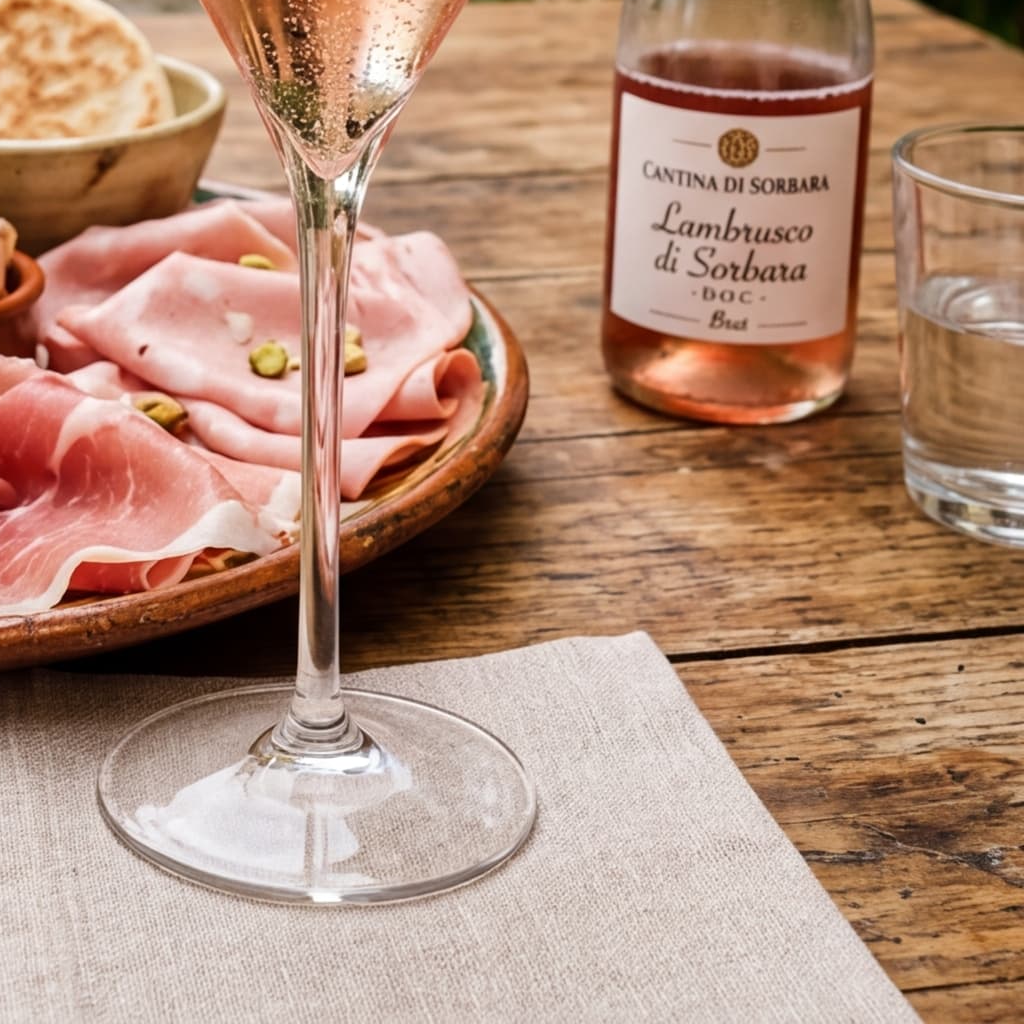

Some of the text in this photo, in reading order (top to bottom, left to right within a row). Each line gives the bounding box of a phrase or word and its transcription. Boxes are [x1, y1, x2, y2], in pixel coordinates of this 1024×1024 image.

[642, 160, 830, 195] CANTINA DI SORBARA
[651, 201, 814, 244] Lambrusco
[654, 241, 808, 283] di Sorbara
